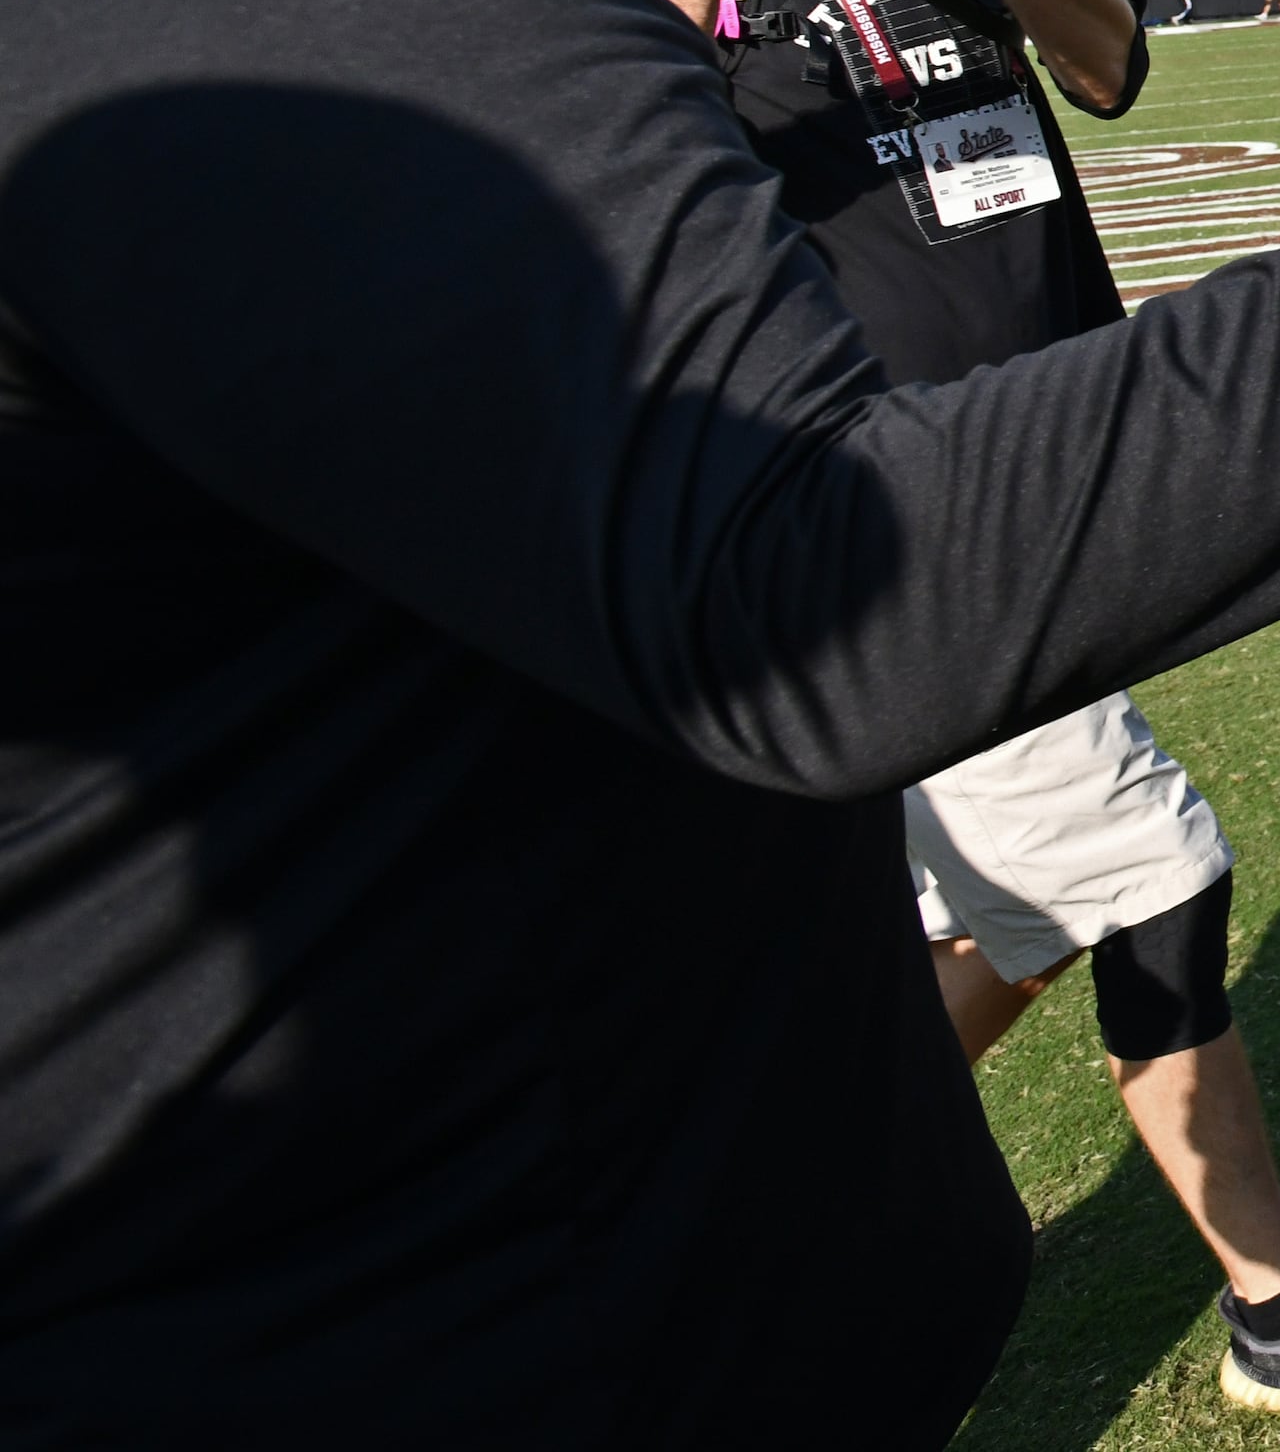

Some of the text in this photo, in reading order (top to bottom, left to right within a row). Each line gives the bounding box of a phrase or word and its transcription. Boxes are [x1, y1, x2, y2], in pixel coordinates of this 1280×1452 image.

[900, 38, 964, 87] VS
[958, 126, 1013, 162] State
[974, 188, 1026, 213] ALL SPORT
